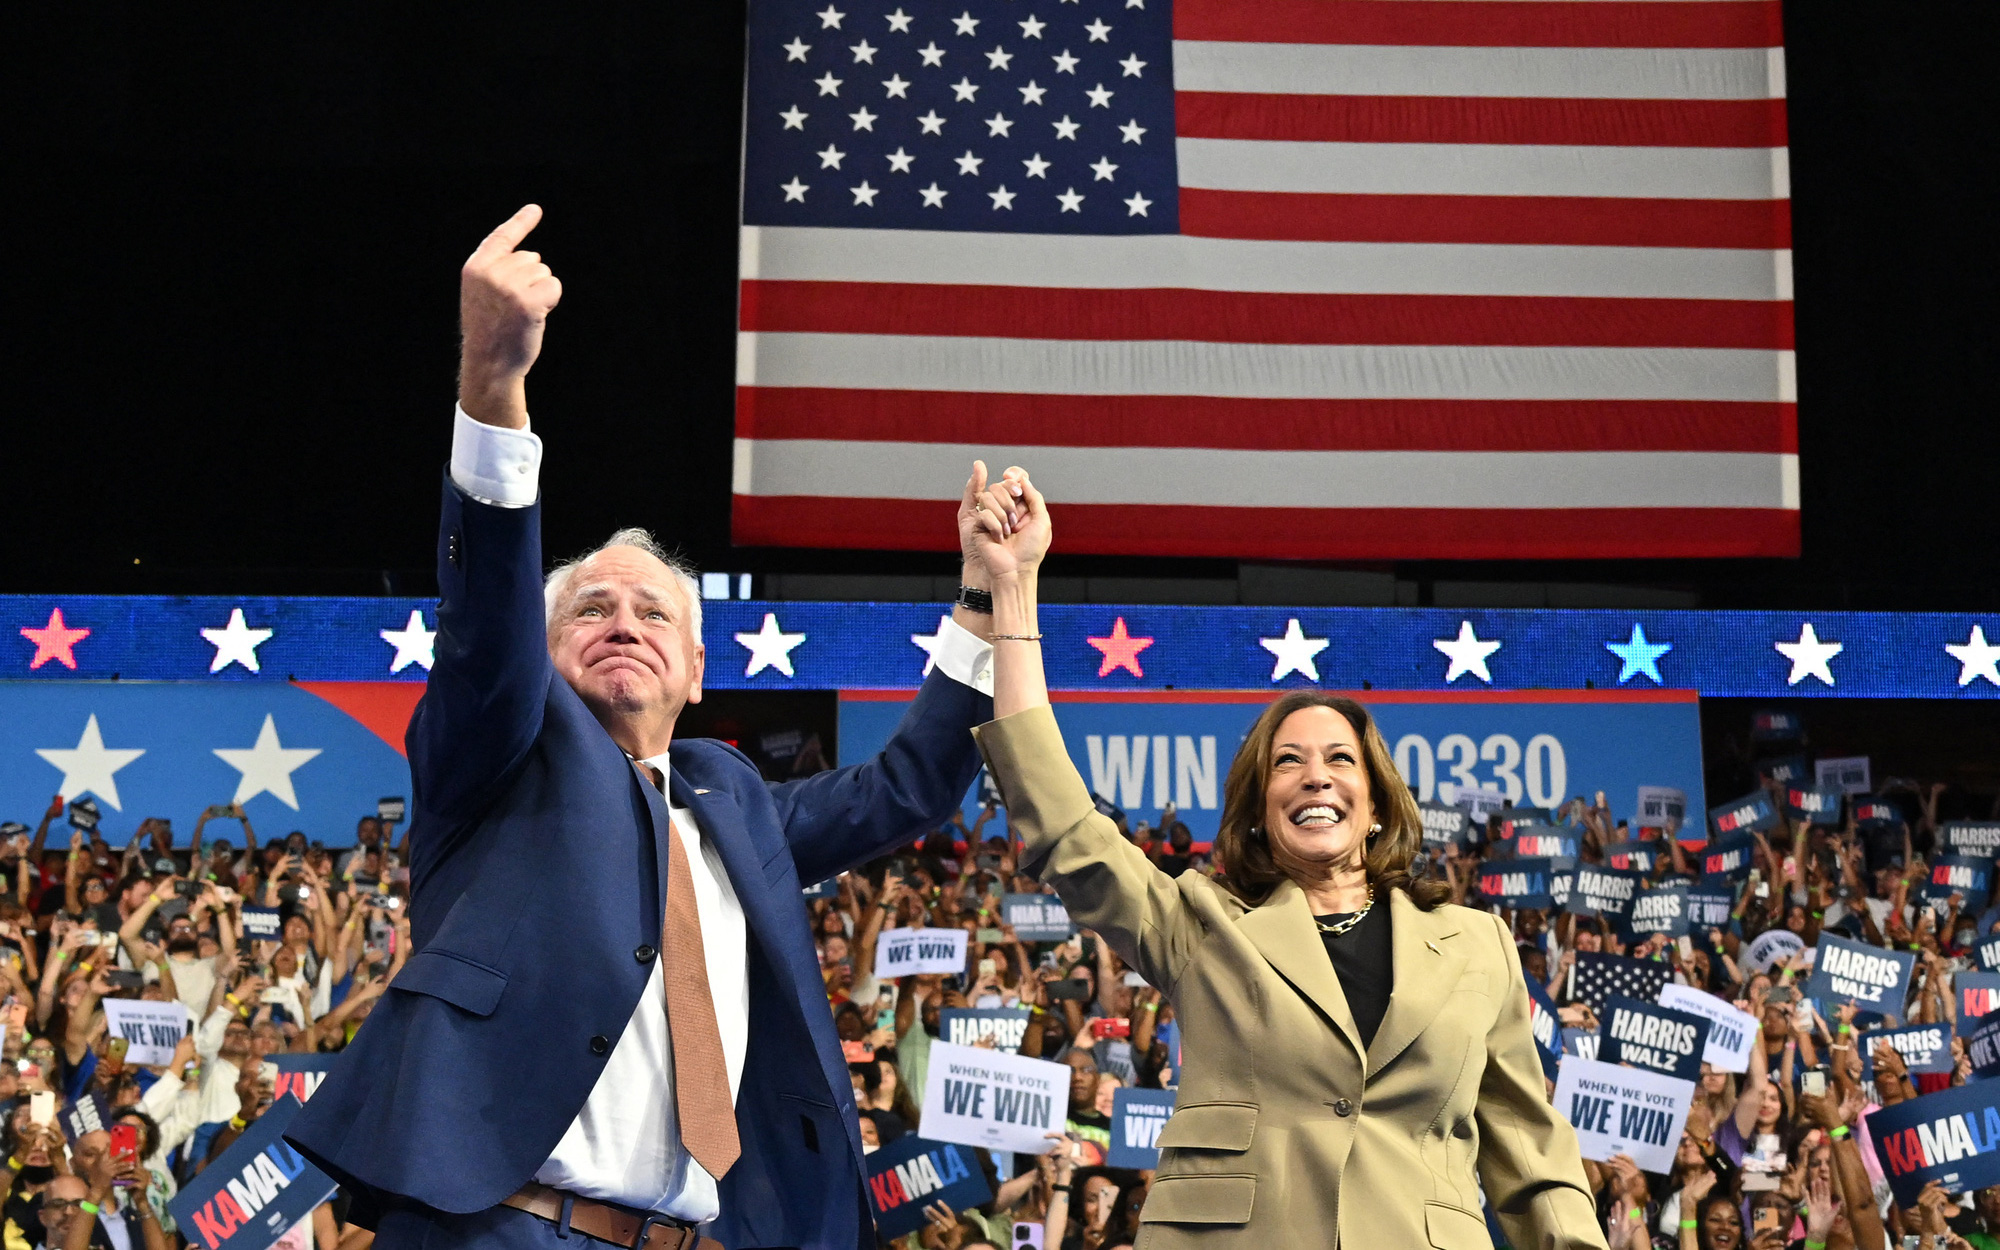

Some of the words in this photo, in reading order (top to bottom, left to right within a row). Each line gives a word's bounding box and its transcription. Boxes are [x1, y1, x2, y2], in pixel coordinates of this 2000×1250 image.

[1086, 734, 1217, 810] WIN
[1420, 808, 1462, 832] ARRIS
[1518, 836, 1577, 858] KAMALA
[1950, 826, 2000, 847] HARRIS
[1481, 872, 1545, 897] KAMALA
[1577, 870, 1635, 901] HARRIS
[888, 945, 912, 964] WE
[918, 944, 955, 960] WIN
[1821, 944, 1901, 988] HARRIS
[1831, 976, 1884, 1003] WALZ
[119, 1021, 148, 1046] WE
[148, 1023, 182, 1048] WIN
[949, 1017, 1028, 1048] HARRIS
[1610, 1007, 1697, 1056] HARRIS
[1620, 1042, 1679, 1072] WALZ
[949, 1063, 990, 1079] WHEN
[993, 1071, 1014, 1084] WE
[1018, 1075, 1050, 1091] VOTE
[944, 1078, 987, 1119] WE
[994, 1086, 1051, 1129] WIN
[1578, 1078, 1618, 1095] WHEN
[1622, 1087, 1641, 1100] WE
[1645, 1092, 1675, 1108] VOTE
[1126, 1103, 1165, 1116] WHEN
[1570, 1092, 1614, 1135] WE
[1619, 1103, 1674, 1147] WIN
[869, 1142, 971, 1213] KAMALA
